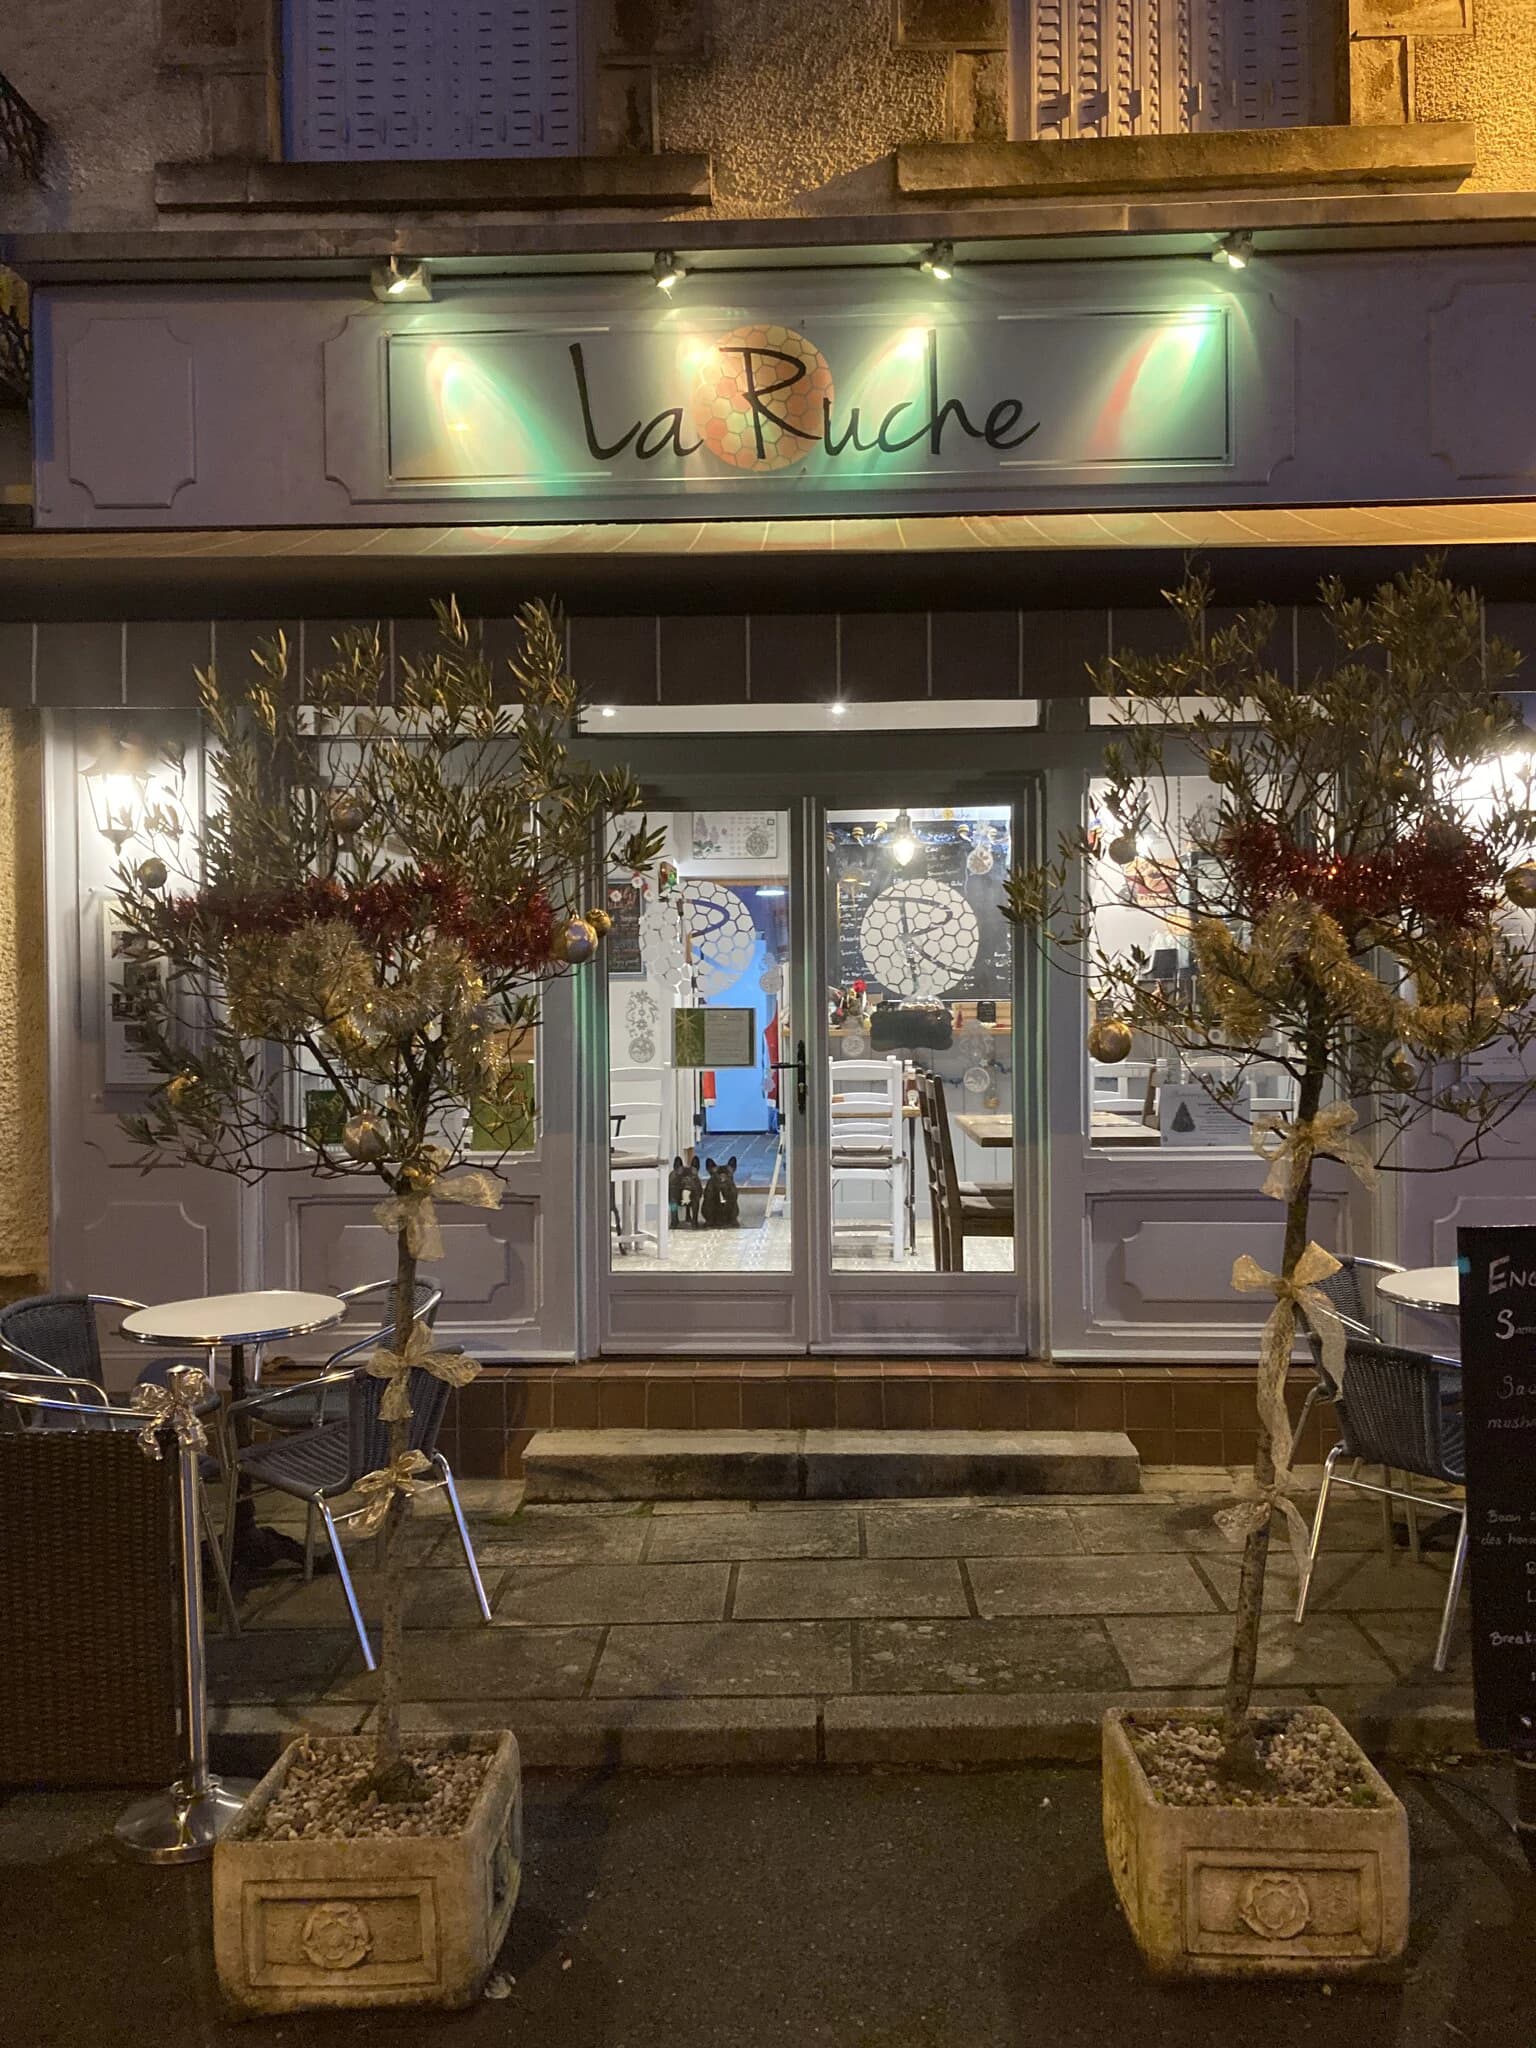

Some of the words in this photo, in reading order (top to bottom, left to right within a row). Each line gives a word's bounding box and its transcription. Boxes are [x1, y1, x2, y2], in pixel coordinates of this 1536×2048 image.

[569, 342, 704, 460] La
[719, 328, 1041, 460] Ruche
[875, 896, 969, 992] R
